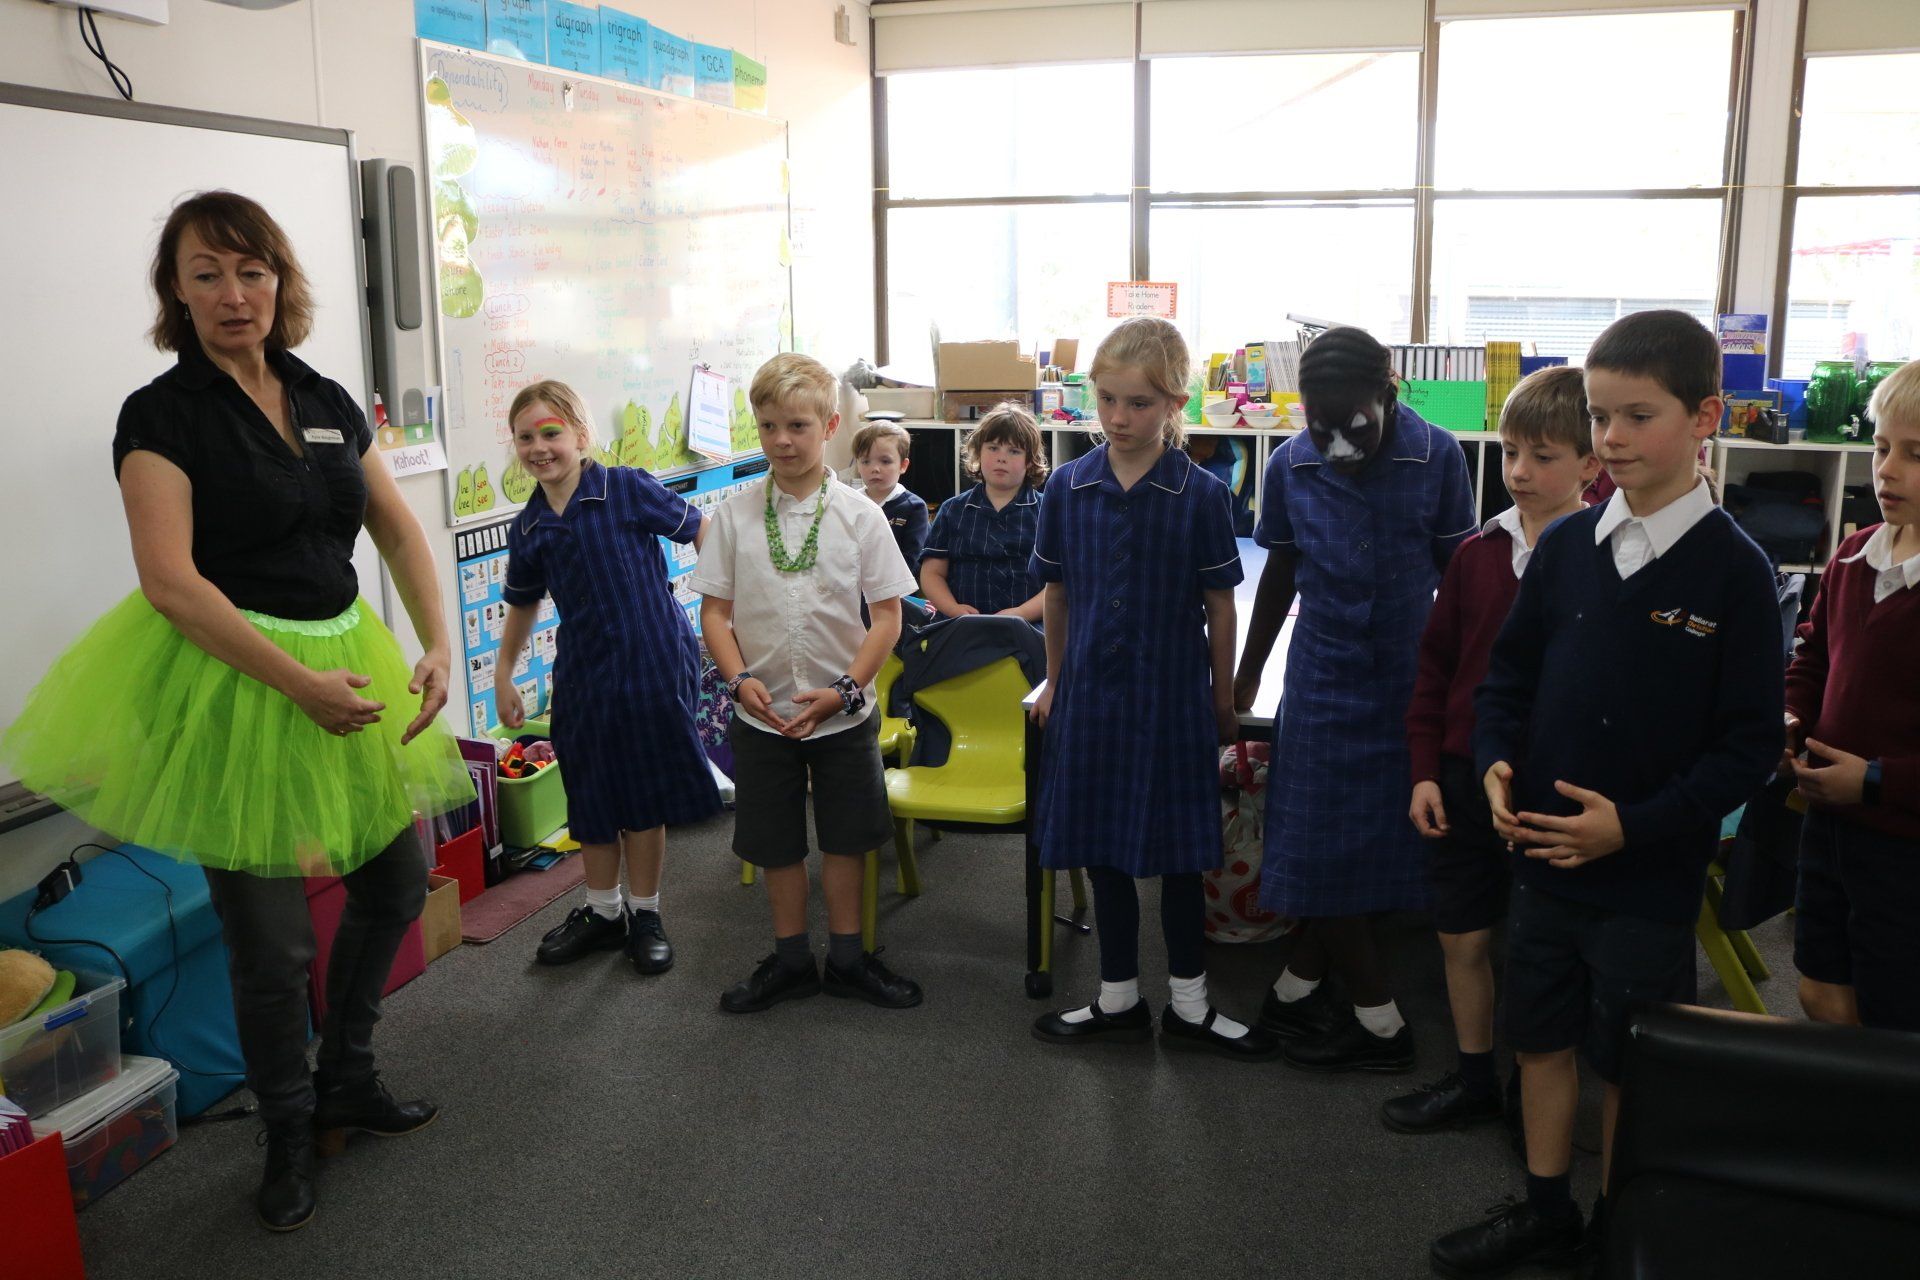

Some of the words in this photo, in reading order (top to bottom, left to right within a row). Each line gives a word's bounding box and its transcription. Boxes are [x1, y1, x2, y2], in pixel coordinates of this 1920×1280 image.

[555, 10, 593, 38] digraph
[607, 20, 643, 47] trigraph
[653, 39, 690, 64] quadgraph
[437, 60, 503, 102] Dependability
[528, 71, 555, 104] Monday
[1142, 290, 1160, 299] Home
[490, 300, 512, 312] Lunch
[491, 353, 510, 368] Lunch
[512, 356, 519, 368] 2
[392, 448, 432, 471] Kahoot!
[476, 479, 487, 491] sea
[458, 496, 470, 510] bee
[477, 494, 488, 507] see
